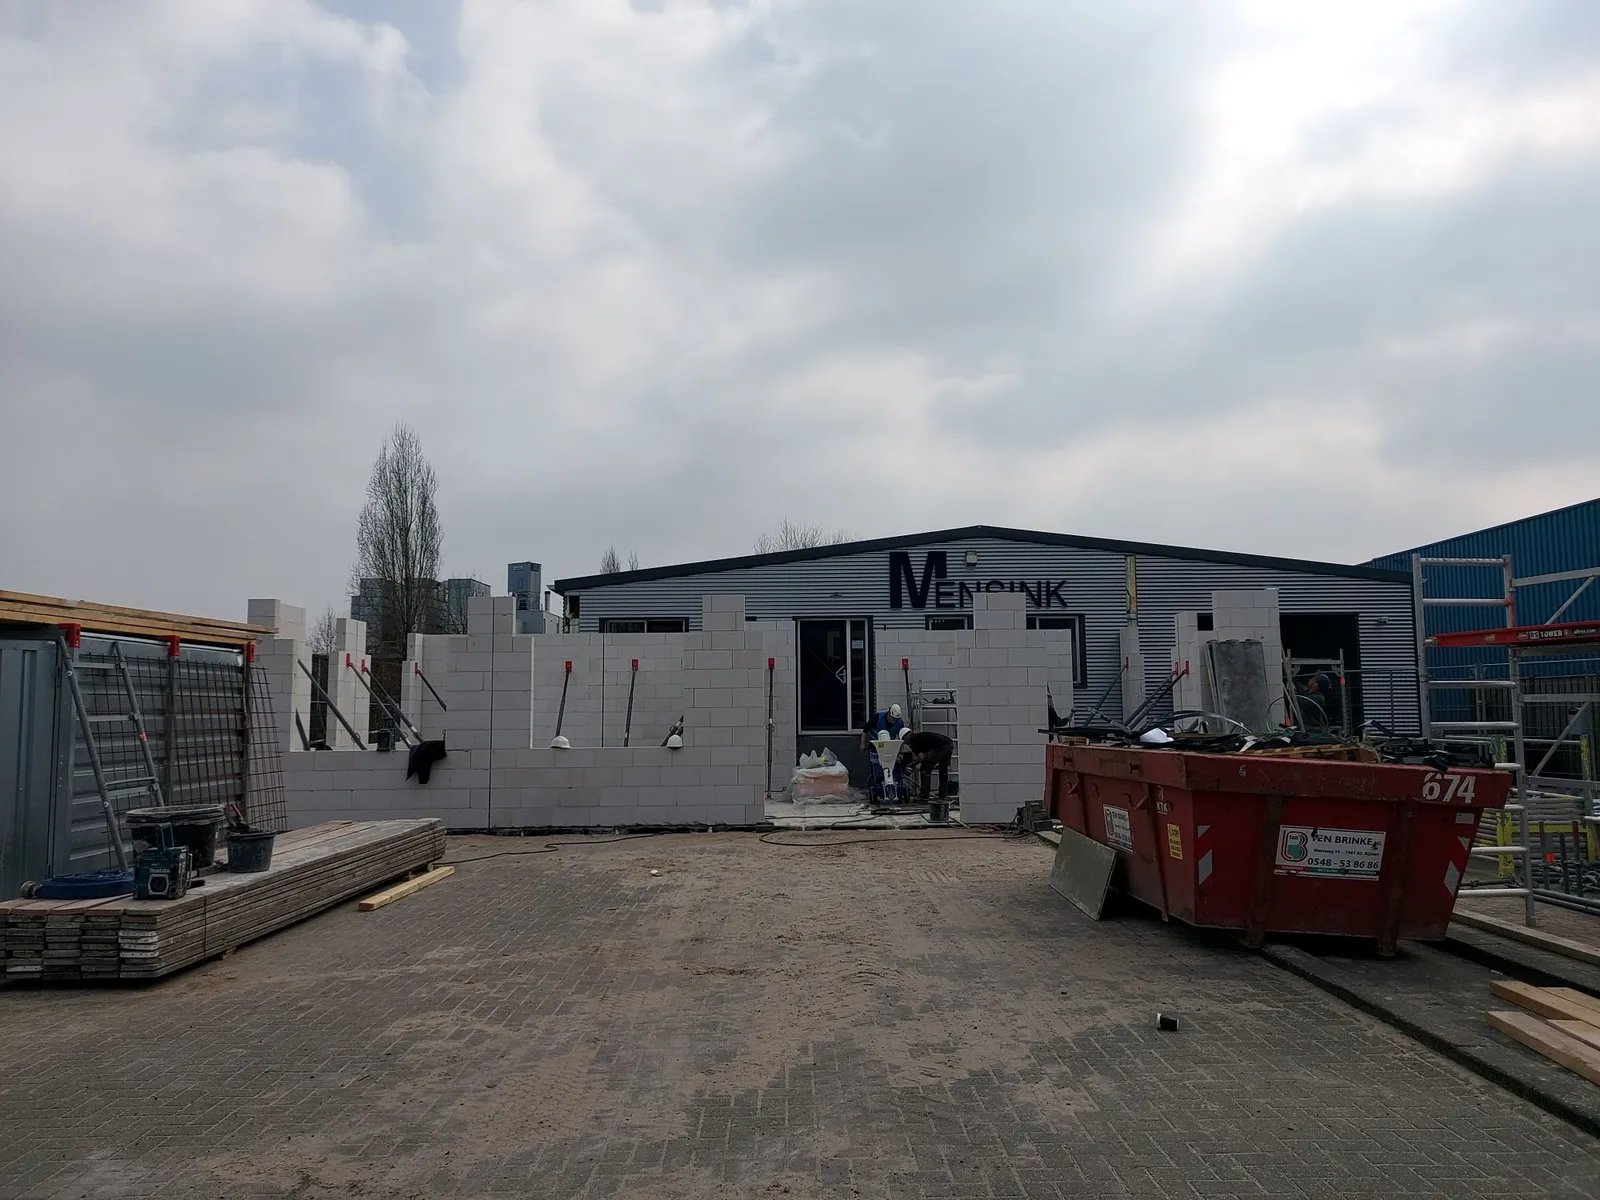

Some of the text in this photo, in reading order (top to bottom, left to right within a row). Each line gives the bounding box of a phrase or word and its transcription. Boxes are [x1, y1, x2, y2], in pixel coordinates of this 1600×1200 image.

[1540, 630, 1563, 638] TOWER
[1422, 771, 1476, 804] 674
[1335, 835, 1373, 846] BRINKE
[1308, 858, 1331, 867] 0548
[1339, 859, 1351, 868] 53
[1353, 860, 1365, 869] 86
[1367, 861, 1379, 869] 86
